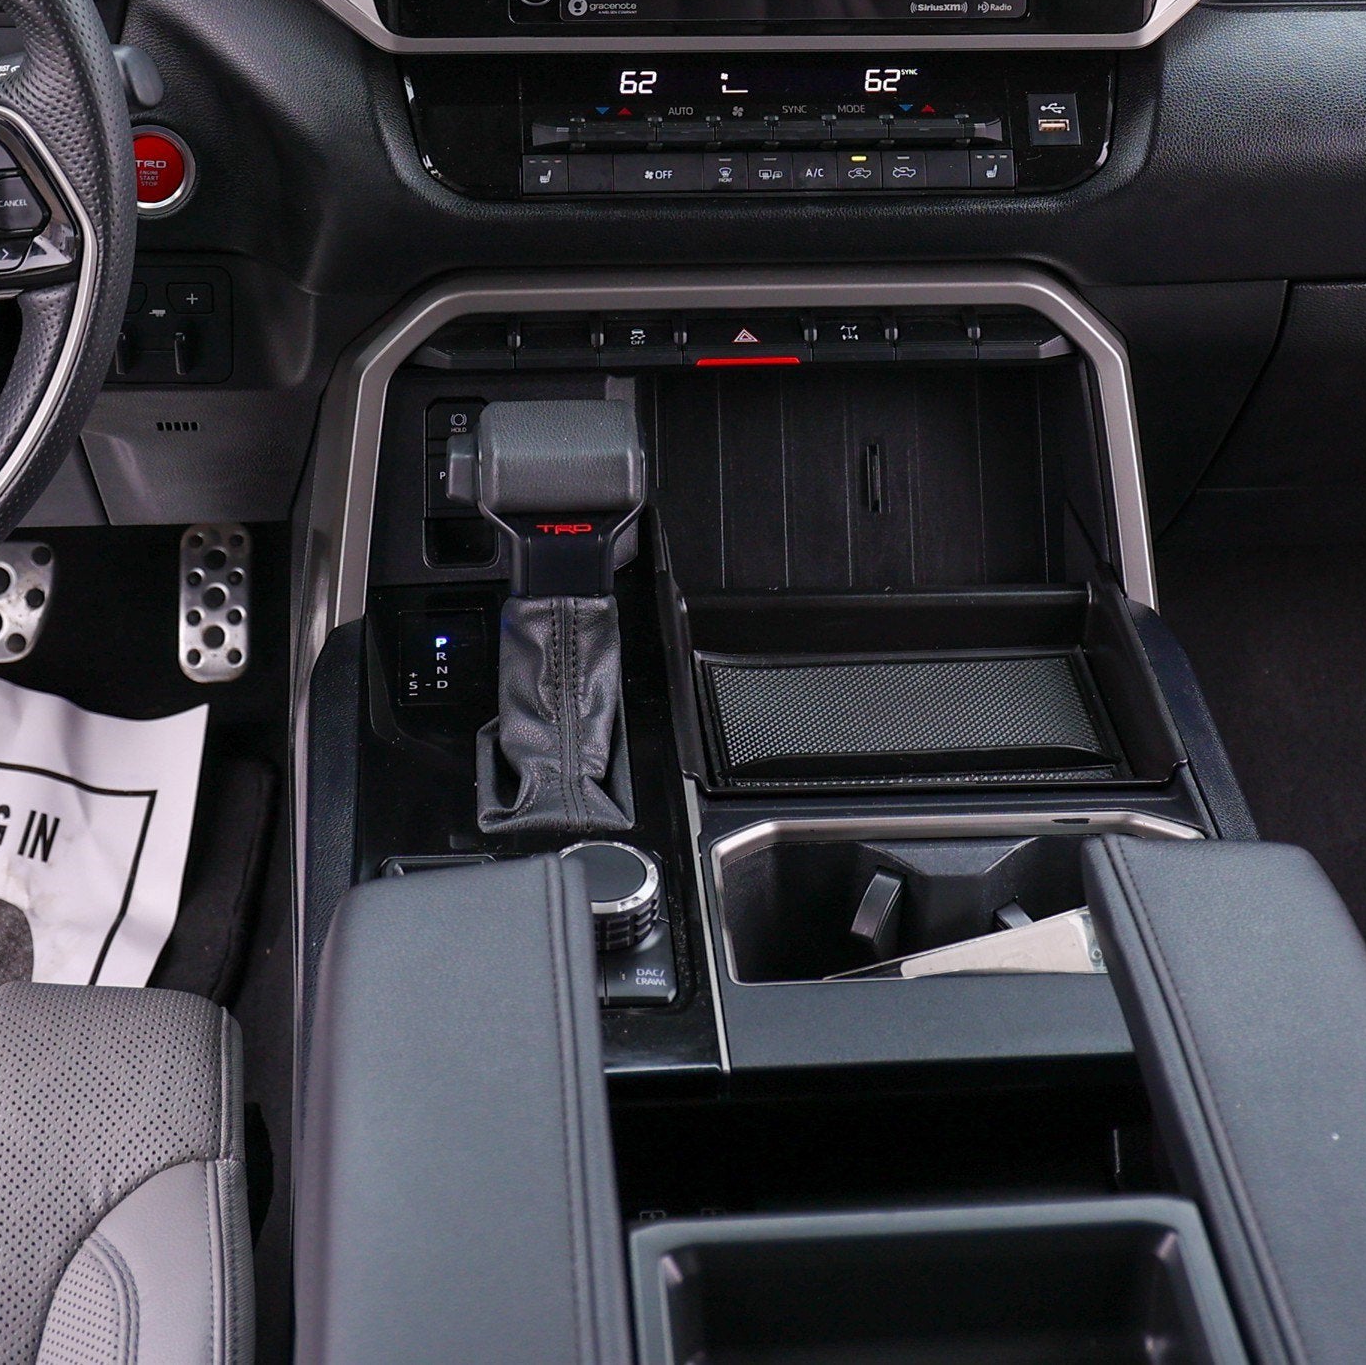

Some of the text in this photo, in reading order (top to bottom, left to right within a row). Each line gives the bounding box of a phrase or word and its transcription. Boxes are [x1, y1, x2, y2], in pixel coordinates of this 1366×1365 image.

[589, 2, 637, 11] gracenote
[990, 3, 1012, 11] Radio
[619, 70, 658, 94] 62
[864, 68, 918, 92] 62 SYNC
[668, 106, 694, 116] AUTO
[782, 105, 807, 114] SYNC
[837, 104, 866, 113] MODE
[135, 160, 167, 168] TRD
[655, 170, 673, 180] OFF
[805, 168, 824, 178] A/C
[536, 524, 592, 534] TRD
[435, 637, 447, 648] P
[436, 652, 447, 661] R
[436, 666, 448, 675] N
[408, 681, 418, 690] S
[437, 680, 448, 689] D
[17, 810, 61, 863] IN
[636, 968, 665, 977] DAC/
[635, 977, 667, 986] CRAWL
